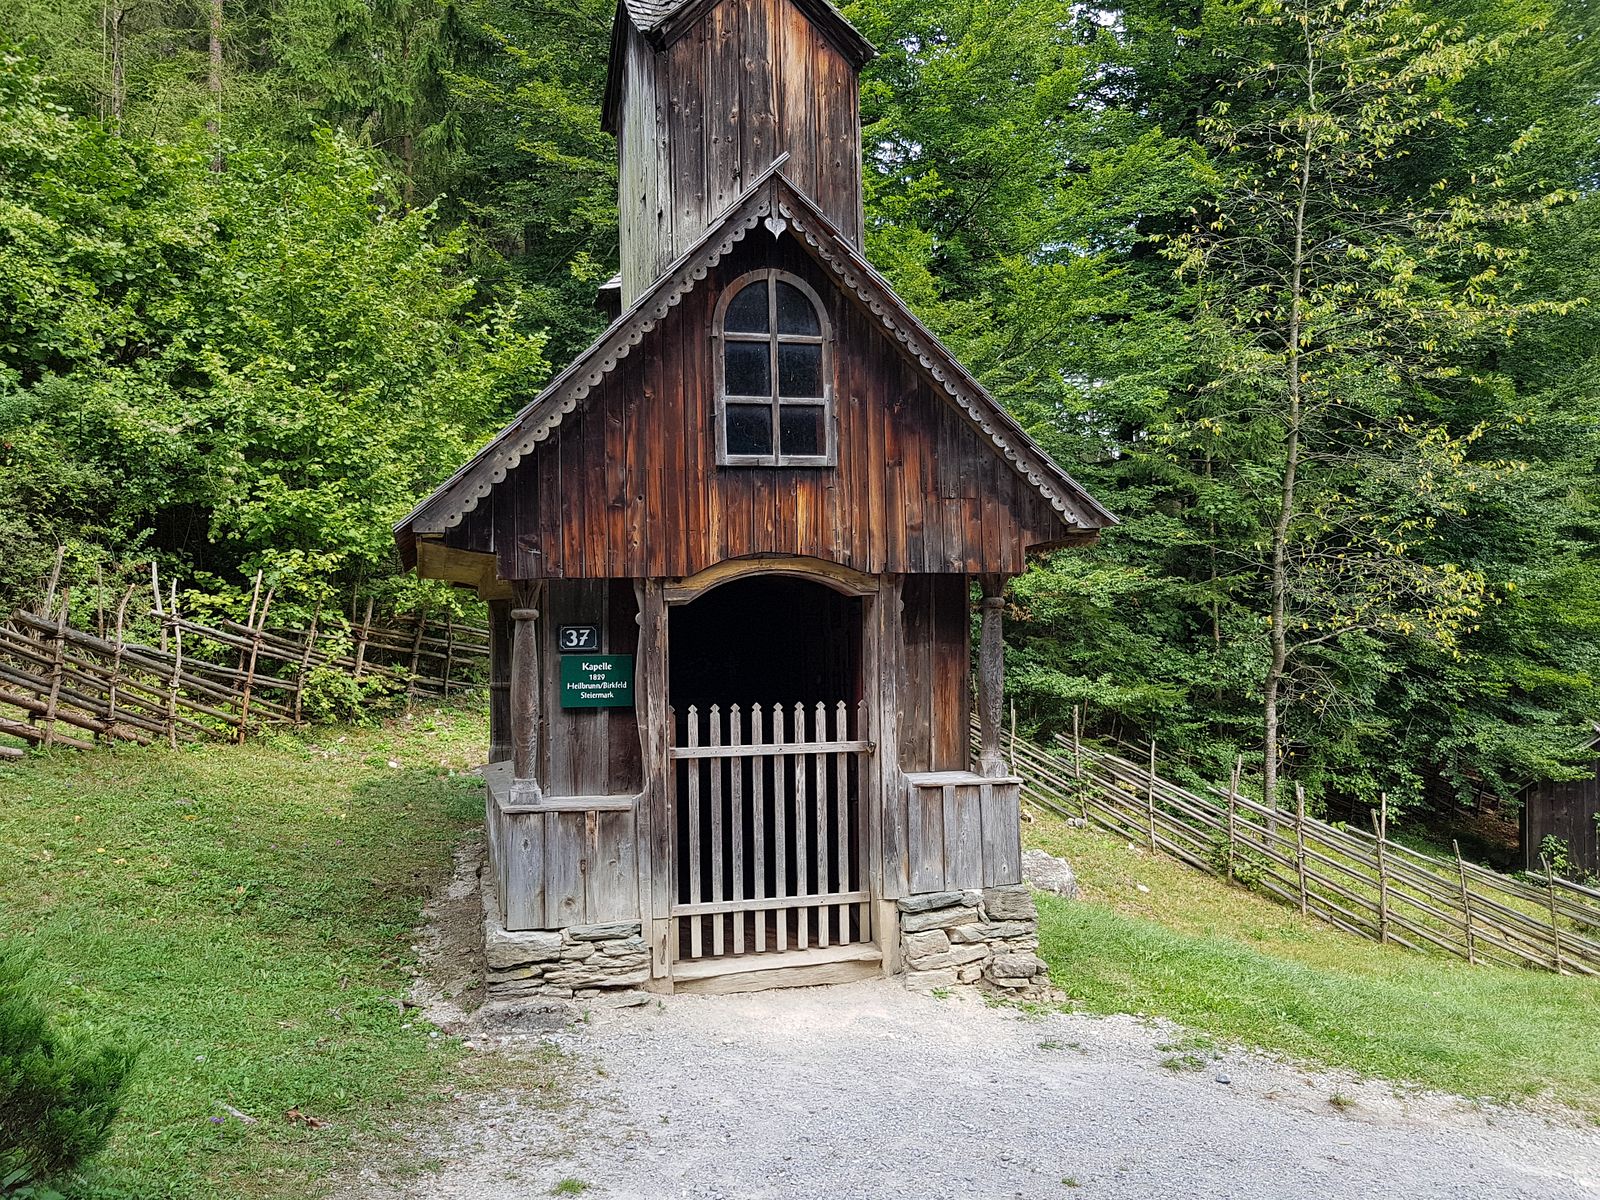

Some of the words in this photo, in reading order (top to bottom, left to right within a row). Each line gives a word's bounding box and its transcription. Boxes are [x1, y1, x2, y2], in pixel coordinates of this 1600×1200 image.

[566, 629, 591, 646] 37
[582, 662, 612, 672] Kapelle
[567, 681, 627, 690] Heilbrunn/Birkfeld
[580, 691, 614, 699] Steiermark
